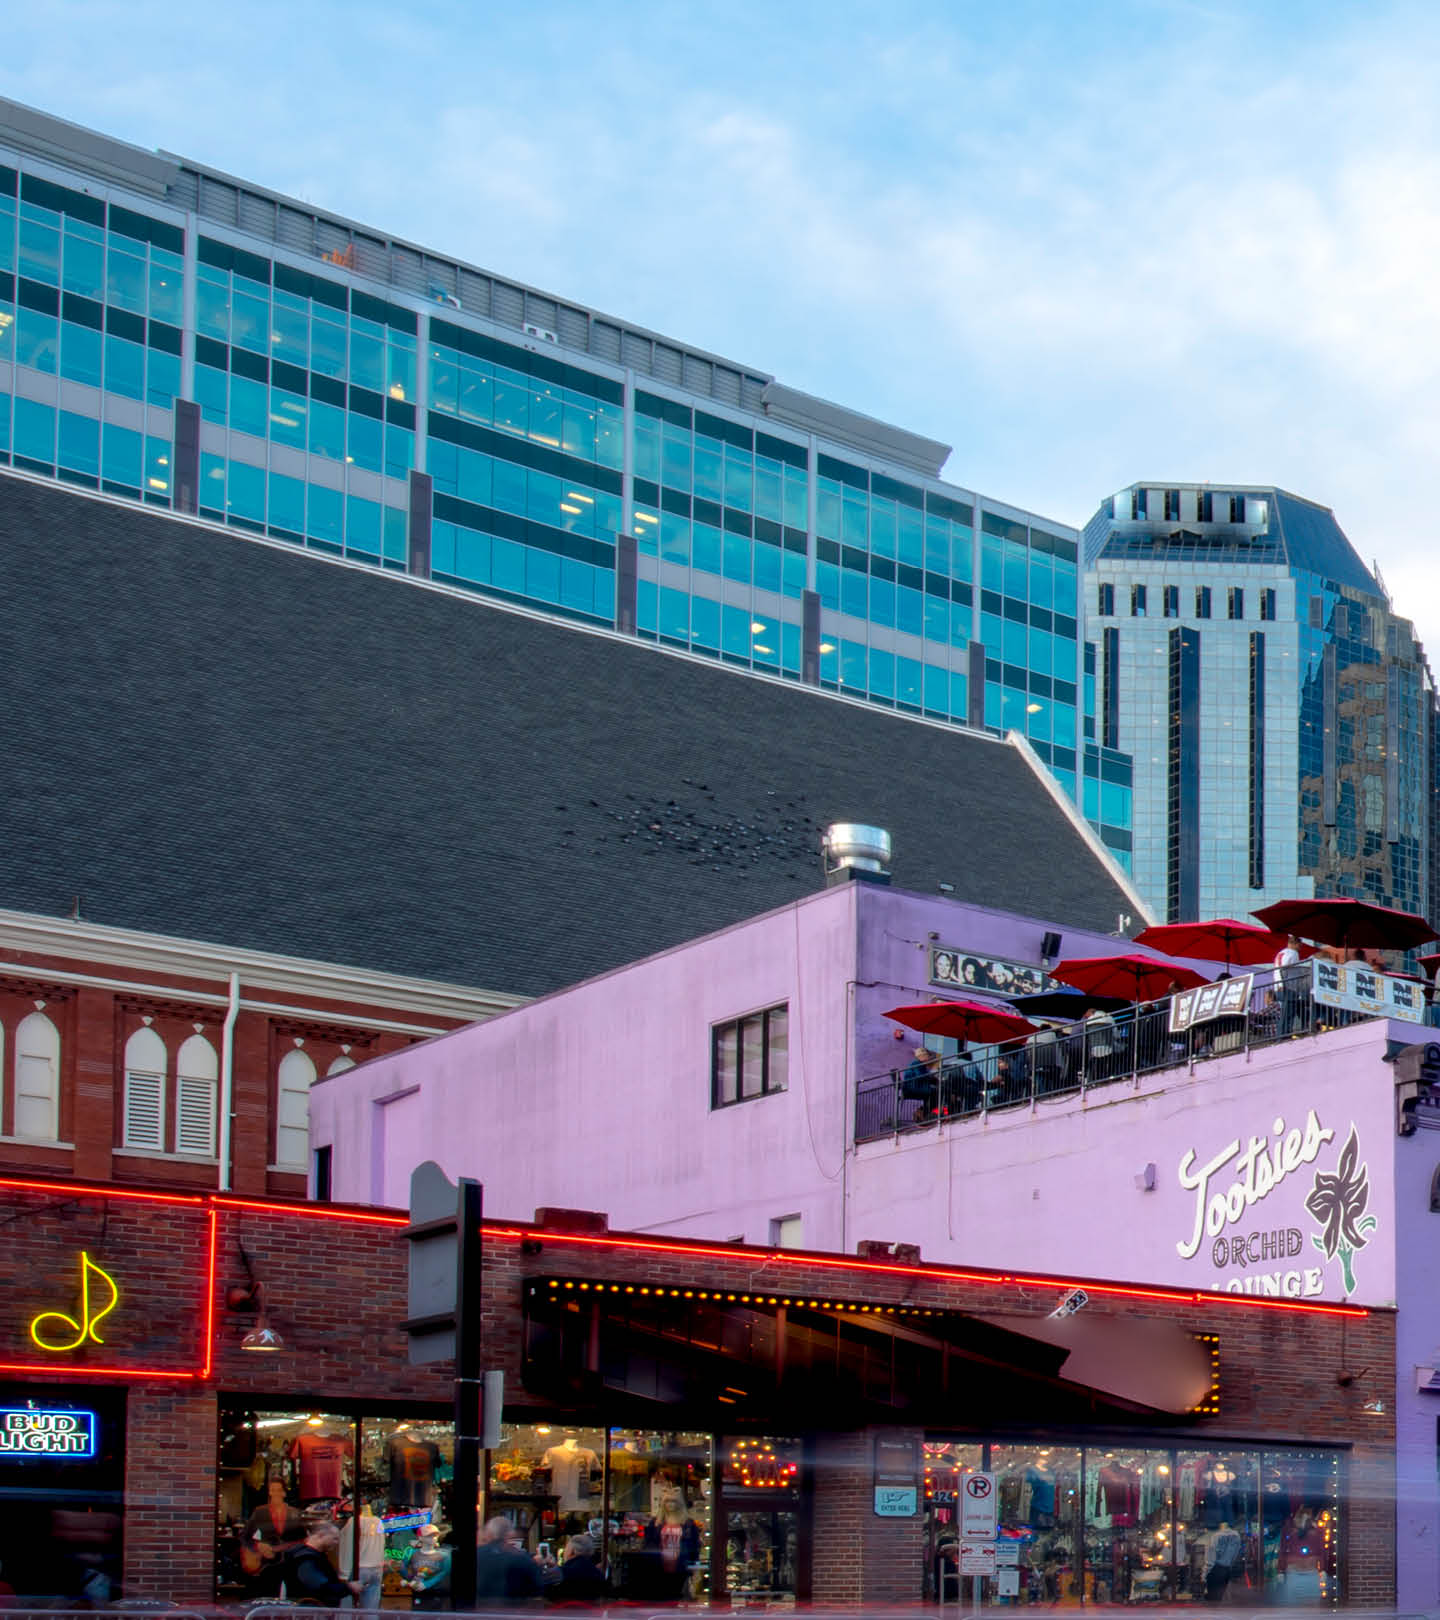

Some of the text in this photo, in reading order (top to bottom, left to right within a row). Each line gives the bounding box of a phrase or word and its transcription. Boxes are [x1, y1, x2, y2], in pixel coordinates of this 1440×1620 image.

[1176, 1109, 1335, 1259] Tootsies
[1212, 1228, 1303, 1267] ORCHID
[1211, 1267, 1324, 1297] OUNGE
[6, 1414, 76, 1432] BUD
[0, 1430, 89, 1452] LIGHT
